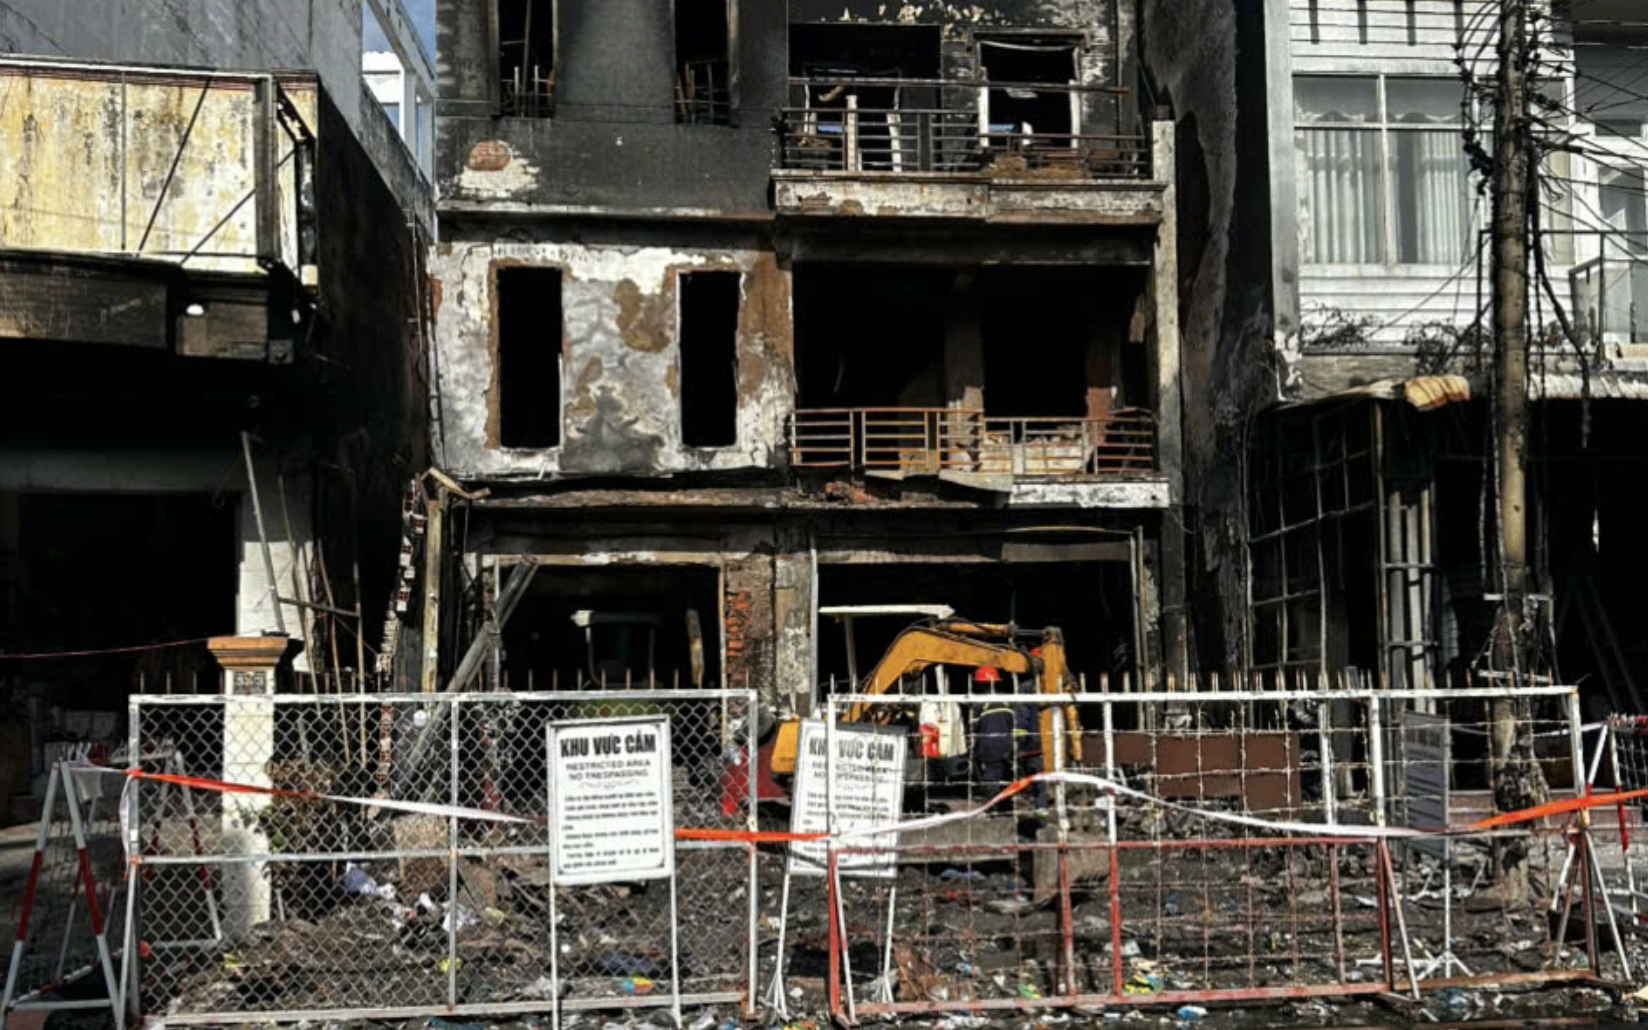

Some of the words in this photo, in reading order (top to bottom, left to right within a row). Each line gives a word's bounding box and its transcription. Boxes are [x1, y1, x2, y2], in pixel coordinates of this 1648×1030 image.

[560, 737, 588, 757] KHU
[593, 733, 621, 758] VỰC
[566, 760, 624, 771] RESTRICTED
[626, 759, 651, 768] AREA
